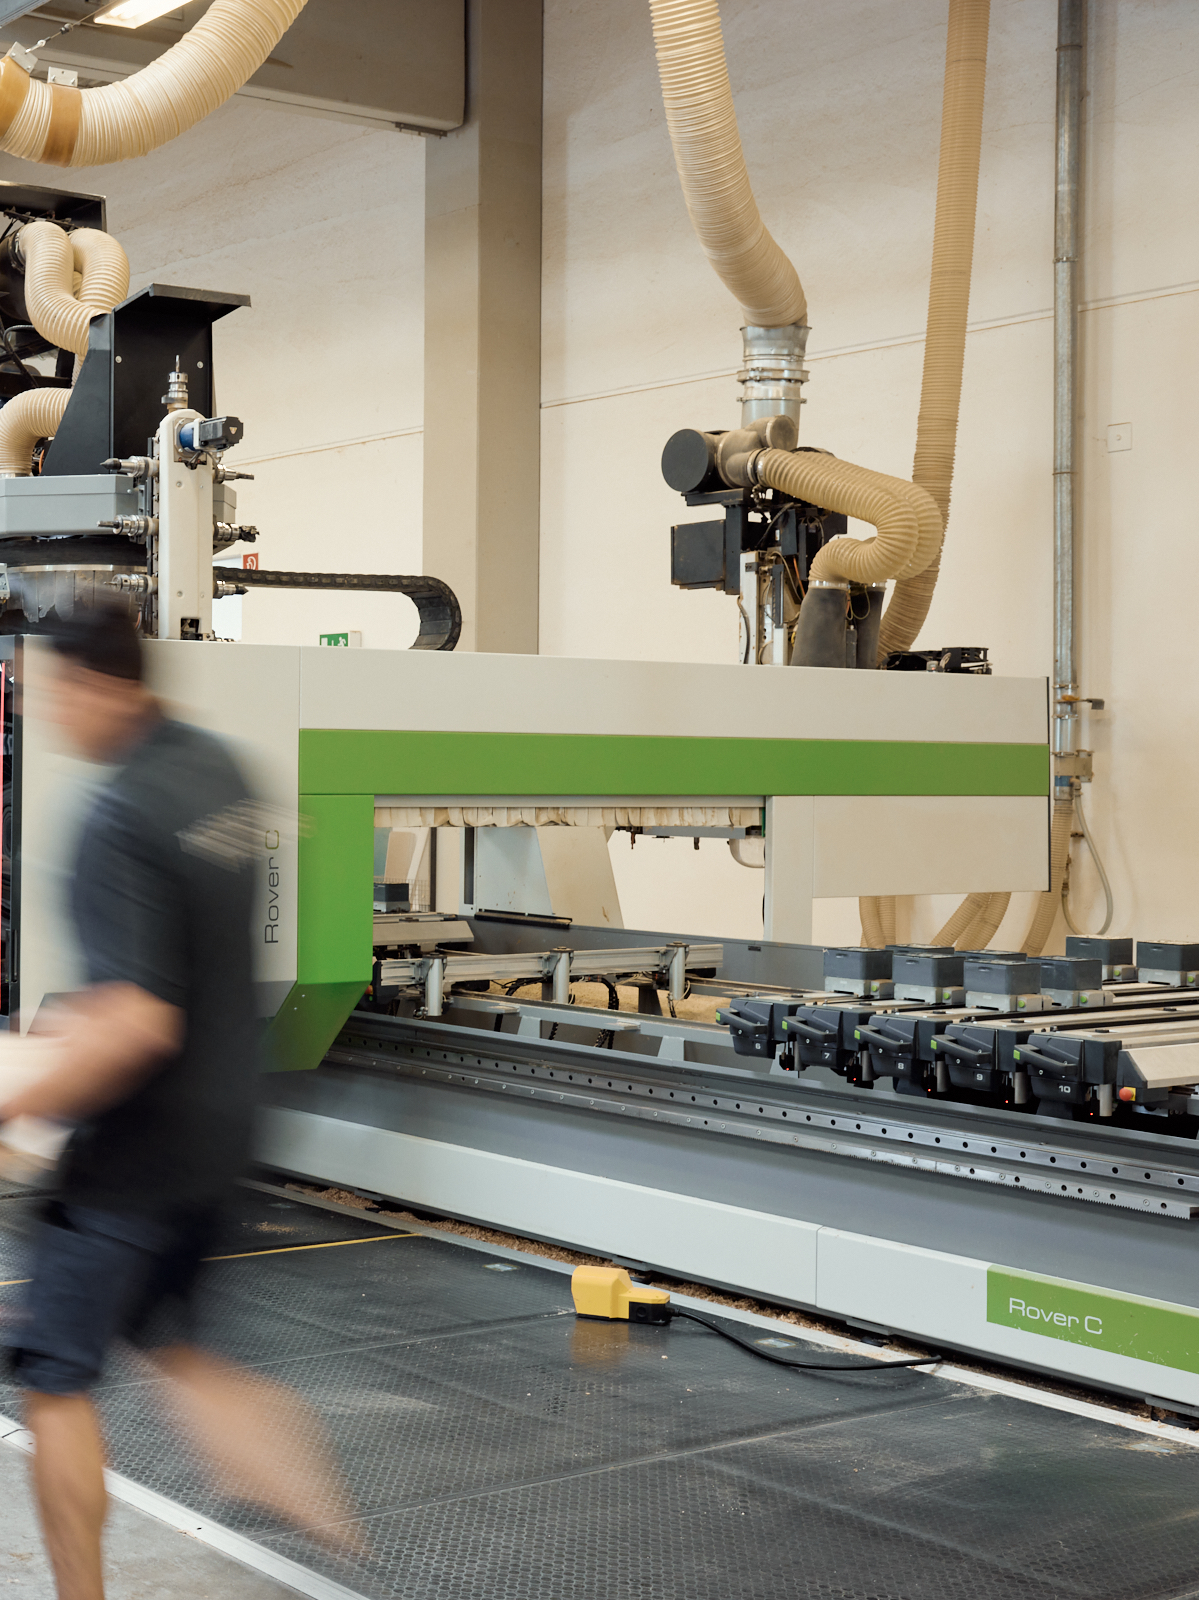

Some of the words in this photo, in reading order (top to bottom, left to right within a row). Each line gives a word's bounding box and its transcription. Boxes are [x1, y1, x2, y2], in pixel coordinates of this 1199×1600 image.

[264, 829, 280, 850] C
[264, 856, 280, 944] Rover
[897, 1062, 904, 1070] 8
[976, 1073, 983, 1081] 9
[1058, 1085, 1071, 1093] 10
[1009, 1297, 1080, 1328] Rover
[1084, 1315, 1103, 1335] C
